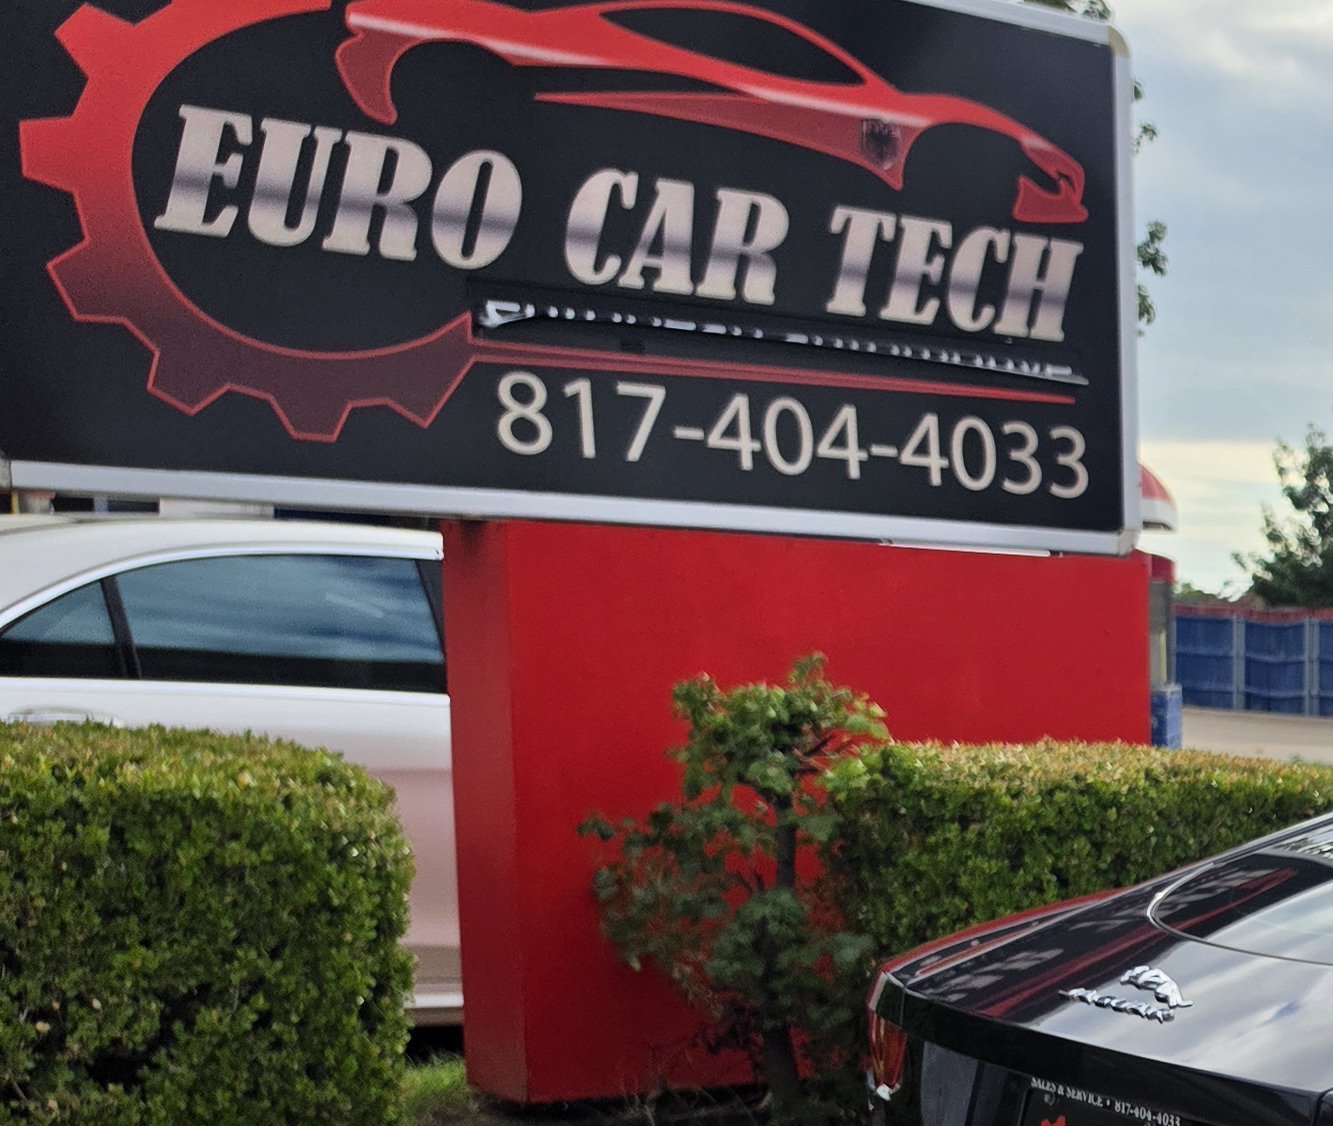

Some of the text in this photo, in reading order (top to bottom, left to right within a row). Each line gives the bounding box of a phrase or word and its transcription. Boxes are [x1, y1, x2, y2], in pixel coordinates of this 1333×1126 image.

[154, 104, 1084, 342] EURO CAR TECH
[496, 370, 1090, 499] 817-404-4033
[1031, 1077, 1057, 1093] SALES
[1066, 1087, 1104, 1108] SERVICE
